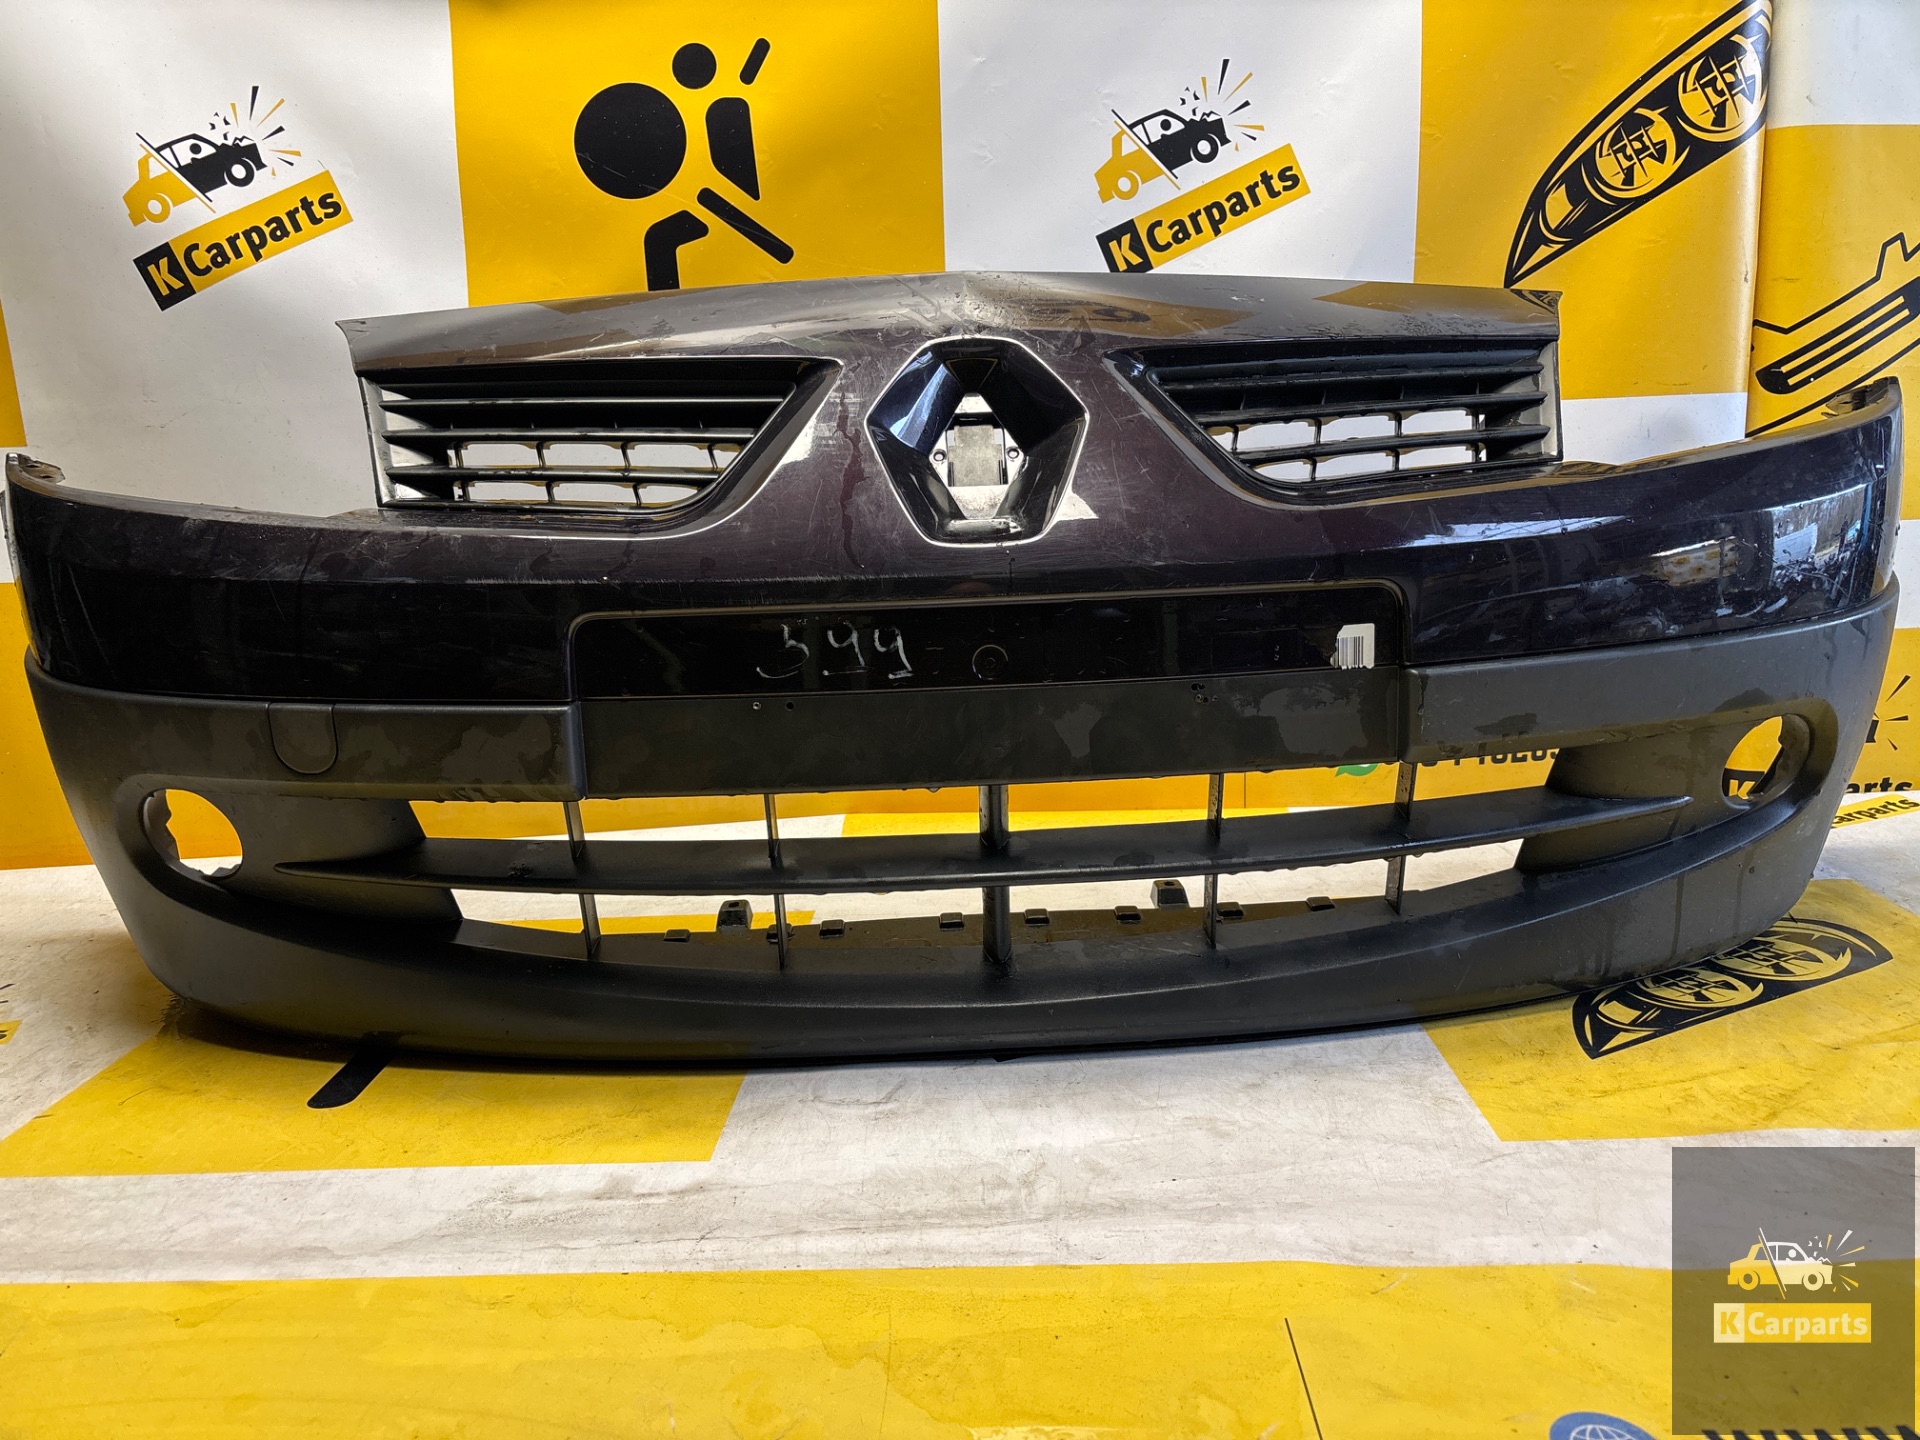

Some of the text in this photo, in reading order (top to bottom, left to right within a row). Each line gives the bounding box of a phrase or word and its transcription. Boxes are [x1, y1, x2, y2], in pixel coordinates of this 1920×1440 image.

[147, 193, 342, 296] K Carparts
[1109, 166, 1300, 271] K Carparts
[1833, 799, 1920, 824] arparts
